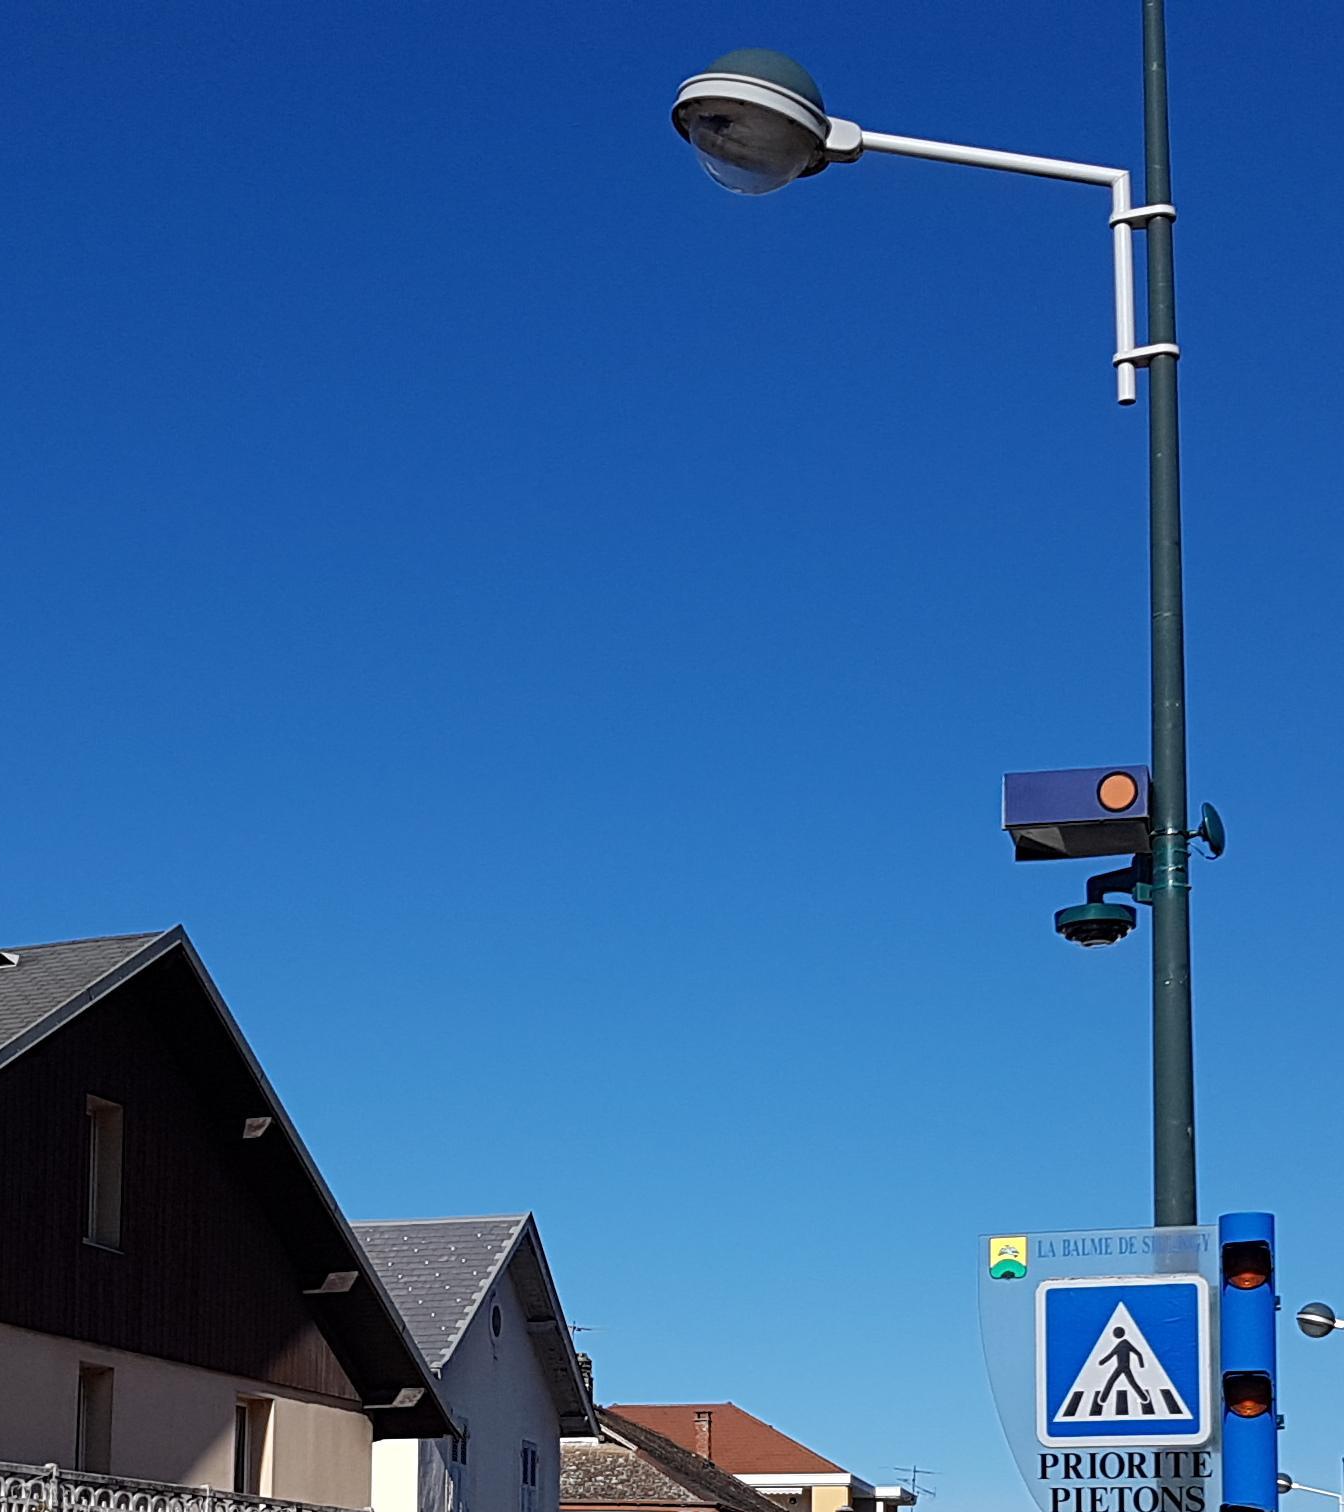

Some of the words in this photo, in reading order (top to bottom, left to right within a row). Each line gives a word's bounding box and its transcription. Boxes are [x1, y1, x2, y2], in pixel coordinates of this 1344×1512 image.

[1037, 1239, 1056, 1258] LA
[1062, 1236, 1113, 1257] BALME
[1118, 1235, 1137, 1255] DE
[1037, 1450, 1214, 1481] PRIORITE
